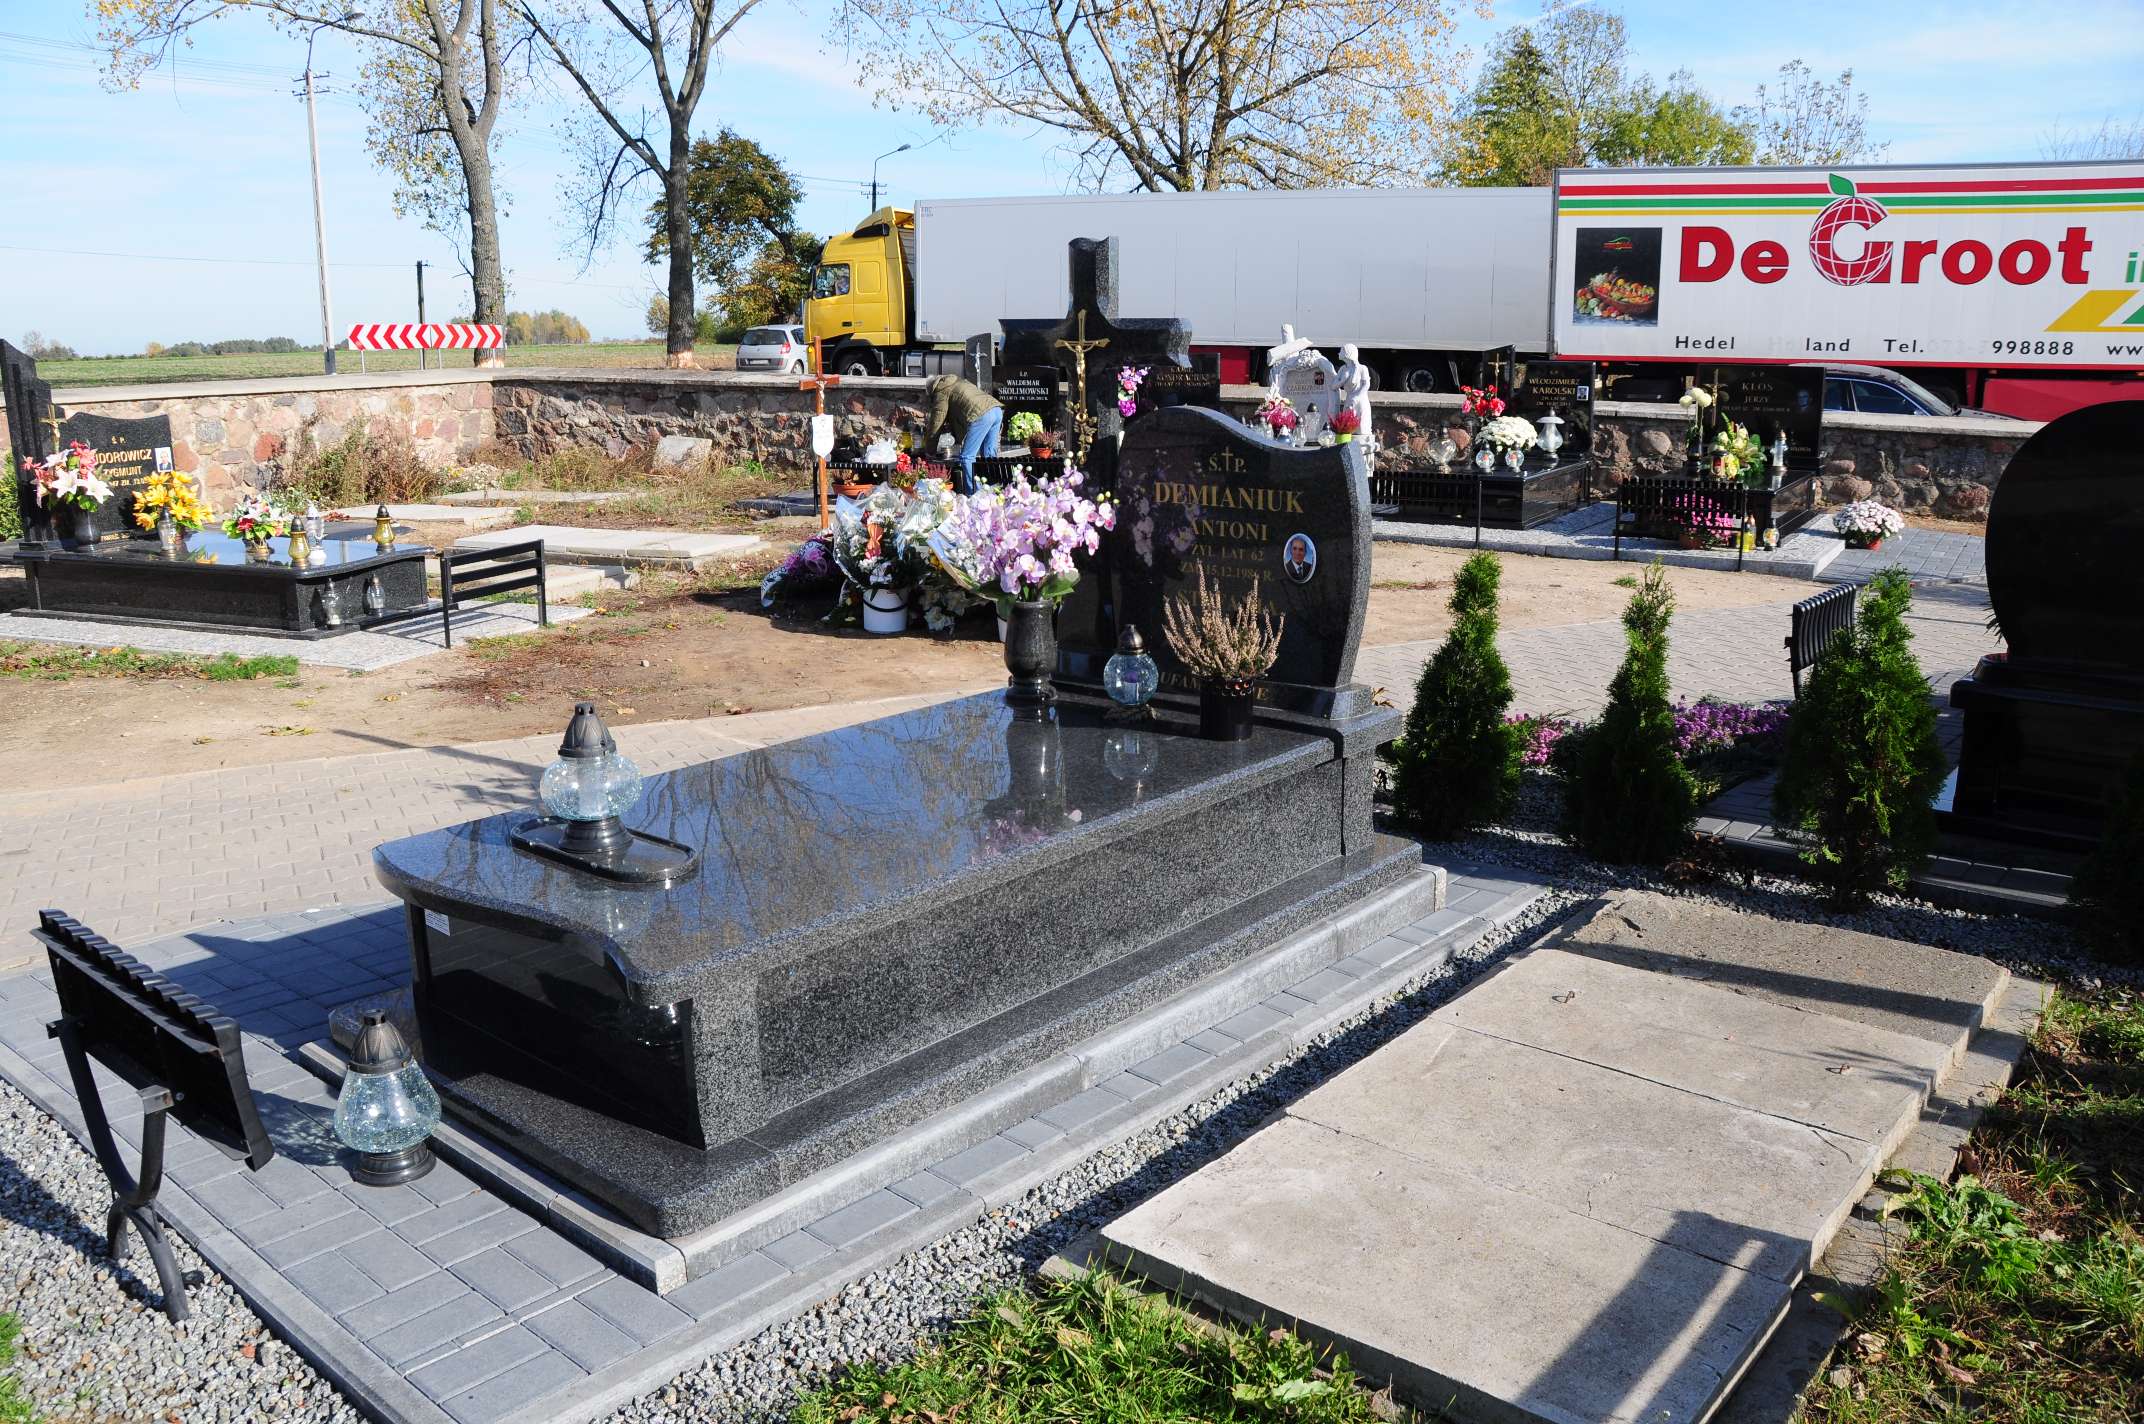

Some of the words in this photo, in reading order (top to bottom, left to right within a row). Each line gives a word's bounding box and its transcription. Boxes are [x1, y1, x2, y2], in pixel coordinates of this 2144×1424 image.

[1679, 226, 1790, 284] De
[1808, 196, 2093, 287] Groot
[1674, 335, 1736, 350] Hedel
[1883, 338, 1924, 354] Tel.
[998, 387, 1050, 396] SKOLIMOWSKI
[1153, 480, 1305, 515] DEMIANIUK
